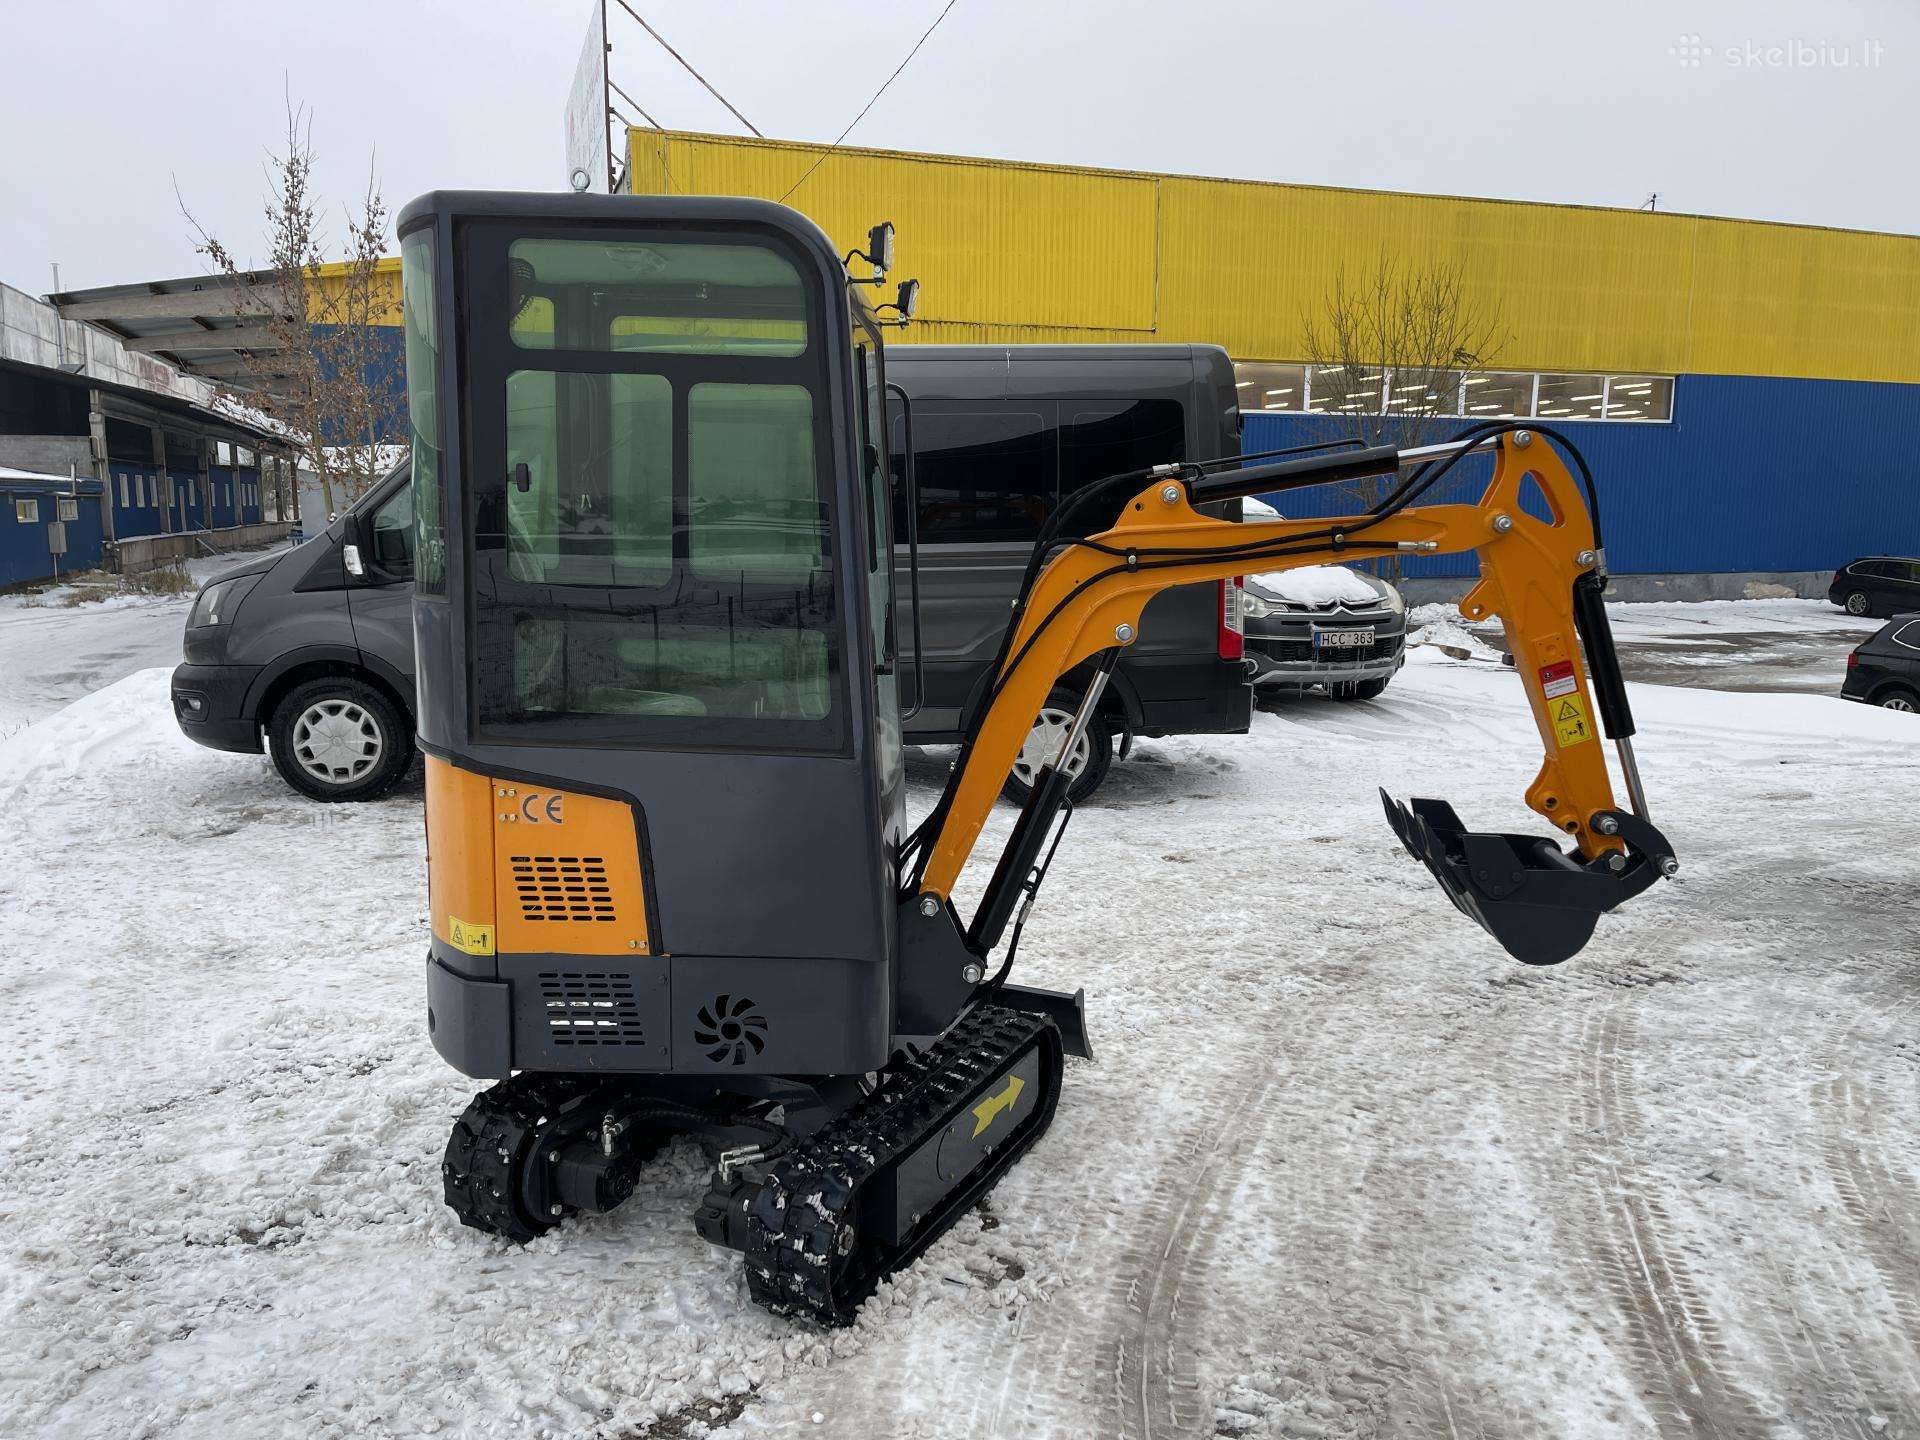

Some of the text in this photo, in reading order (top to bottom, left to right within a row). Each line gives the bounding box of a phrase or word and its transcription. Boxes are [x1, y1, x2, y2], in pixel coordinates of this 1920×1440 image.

[1322, 632, 1373, 645] HCC 363
[522, 794, 563, 824] CE
